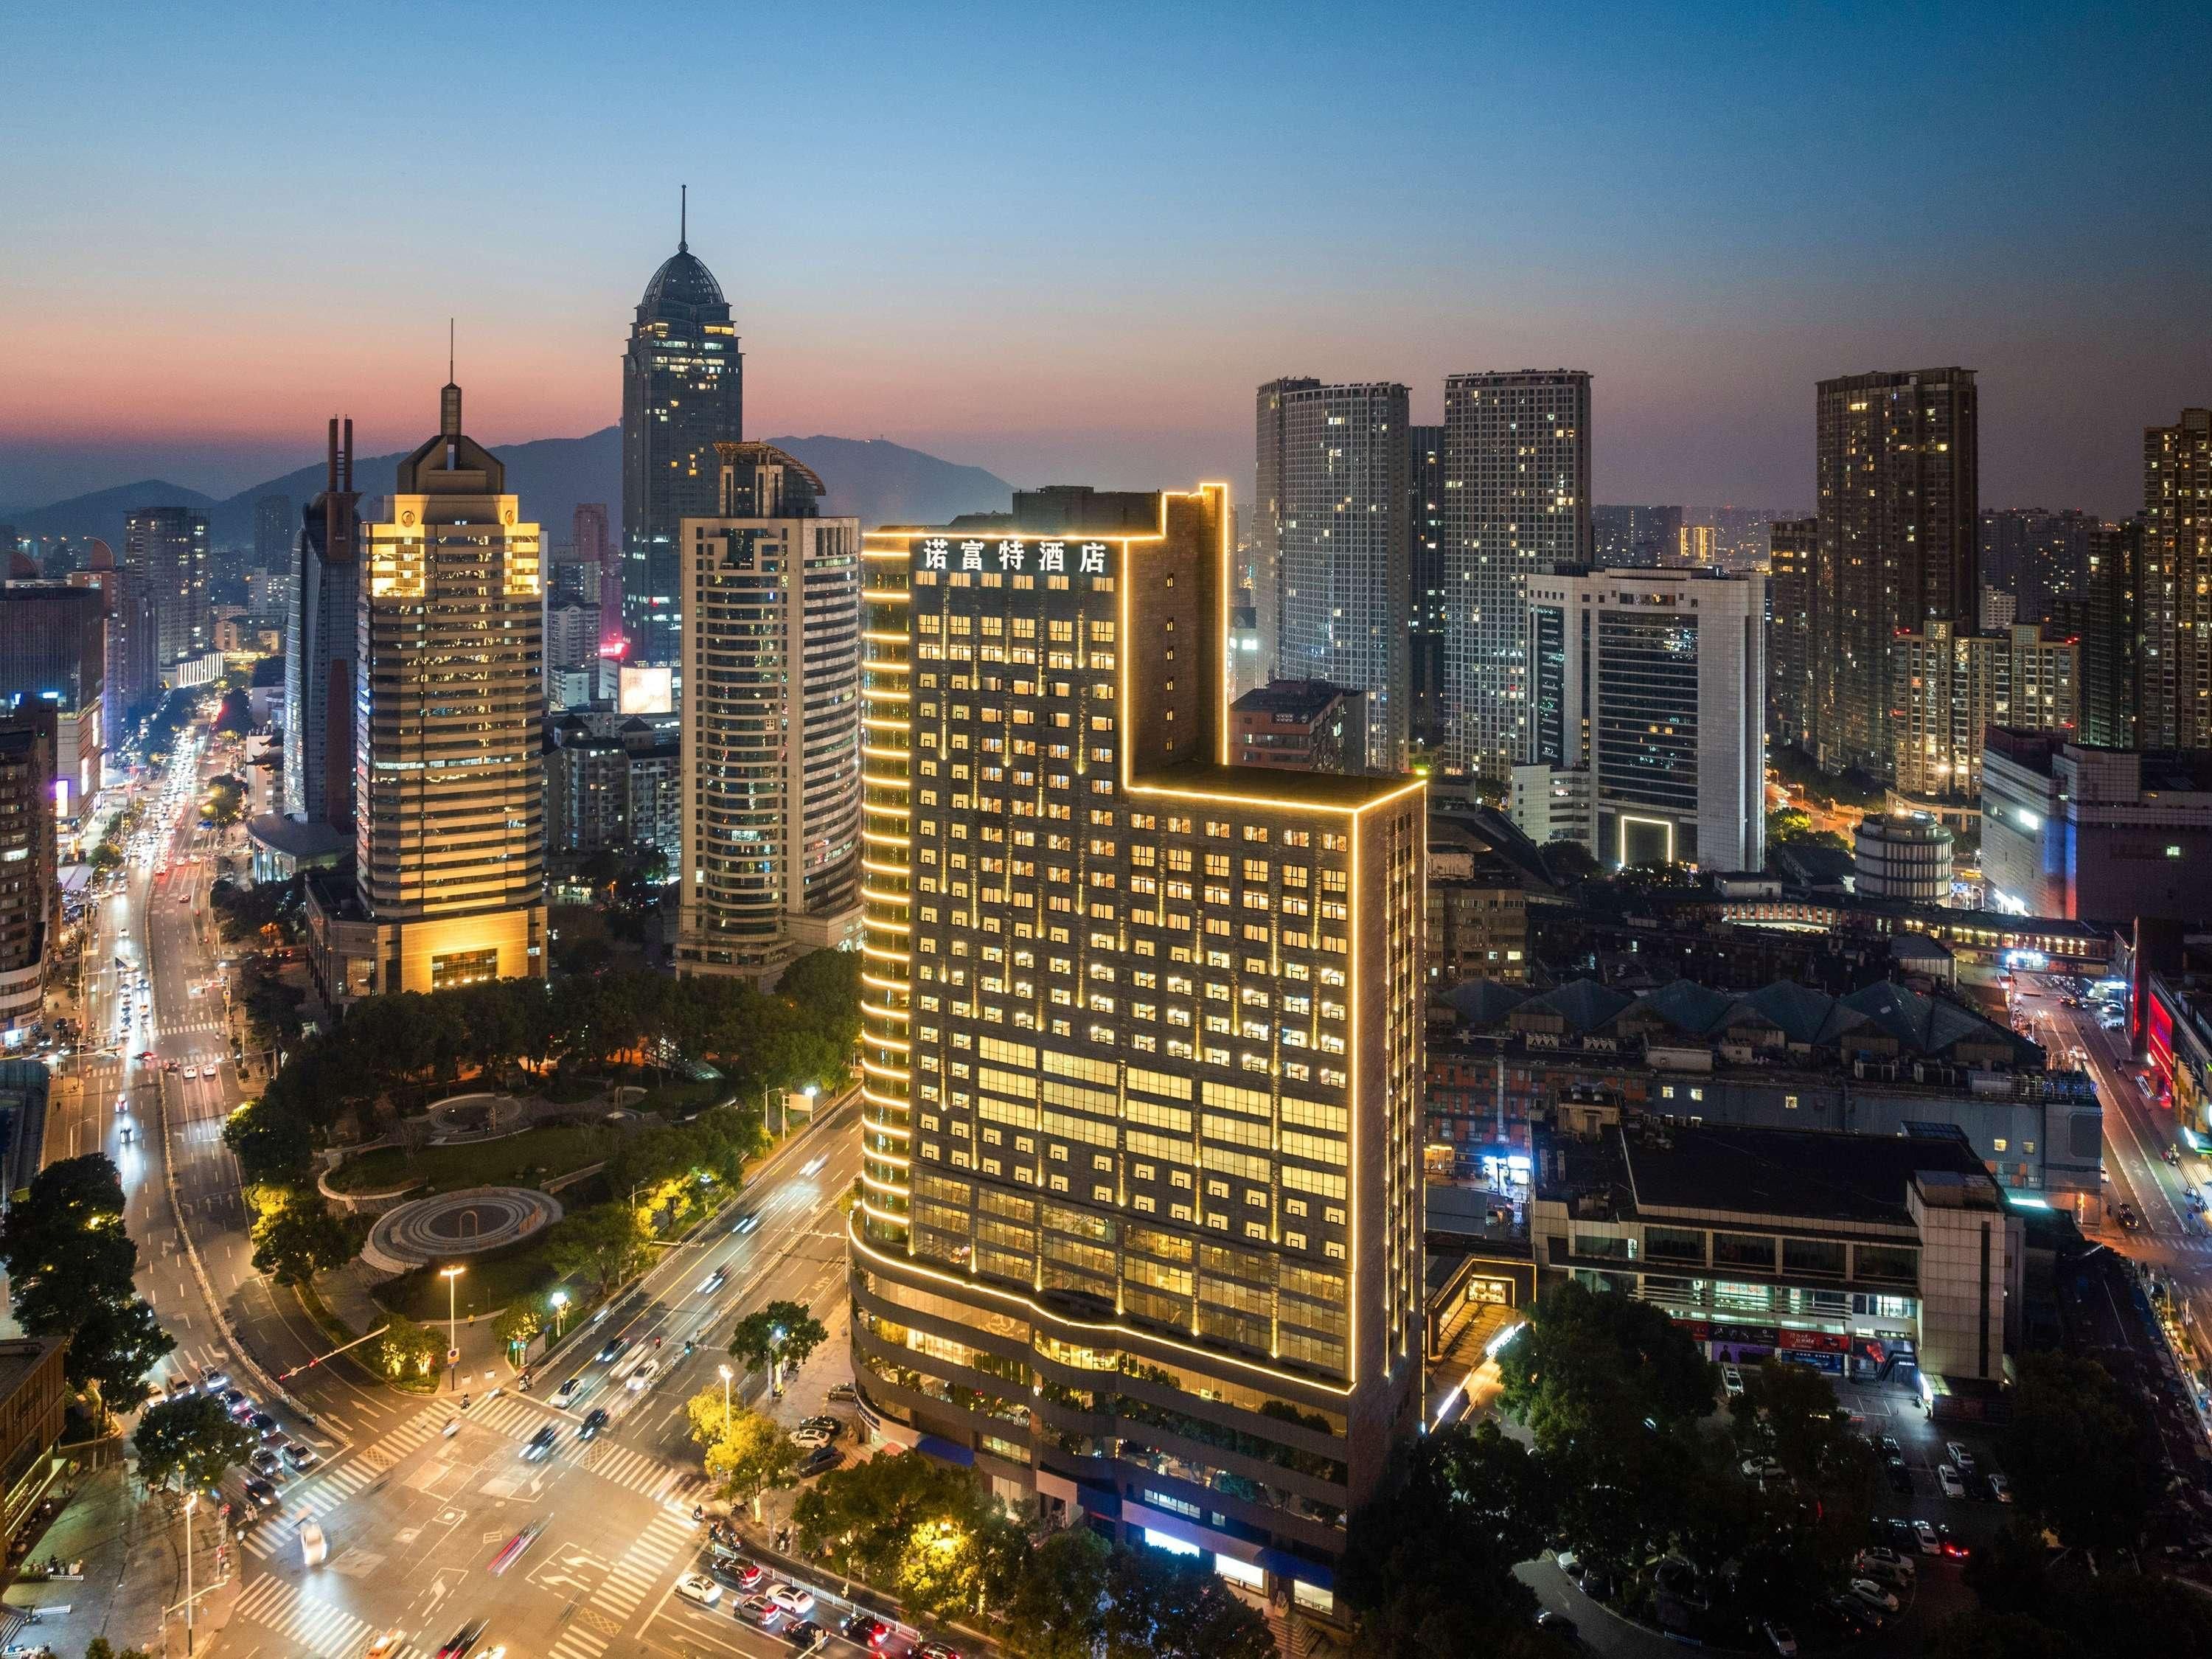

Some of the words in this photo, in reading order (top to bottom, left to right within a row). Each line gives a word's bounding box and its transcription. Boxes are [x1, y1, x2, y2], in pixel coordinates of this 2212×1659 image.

[923, 539, 1107, 573] 诺富特酒店
